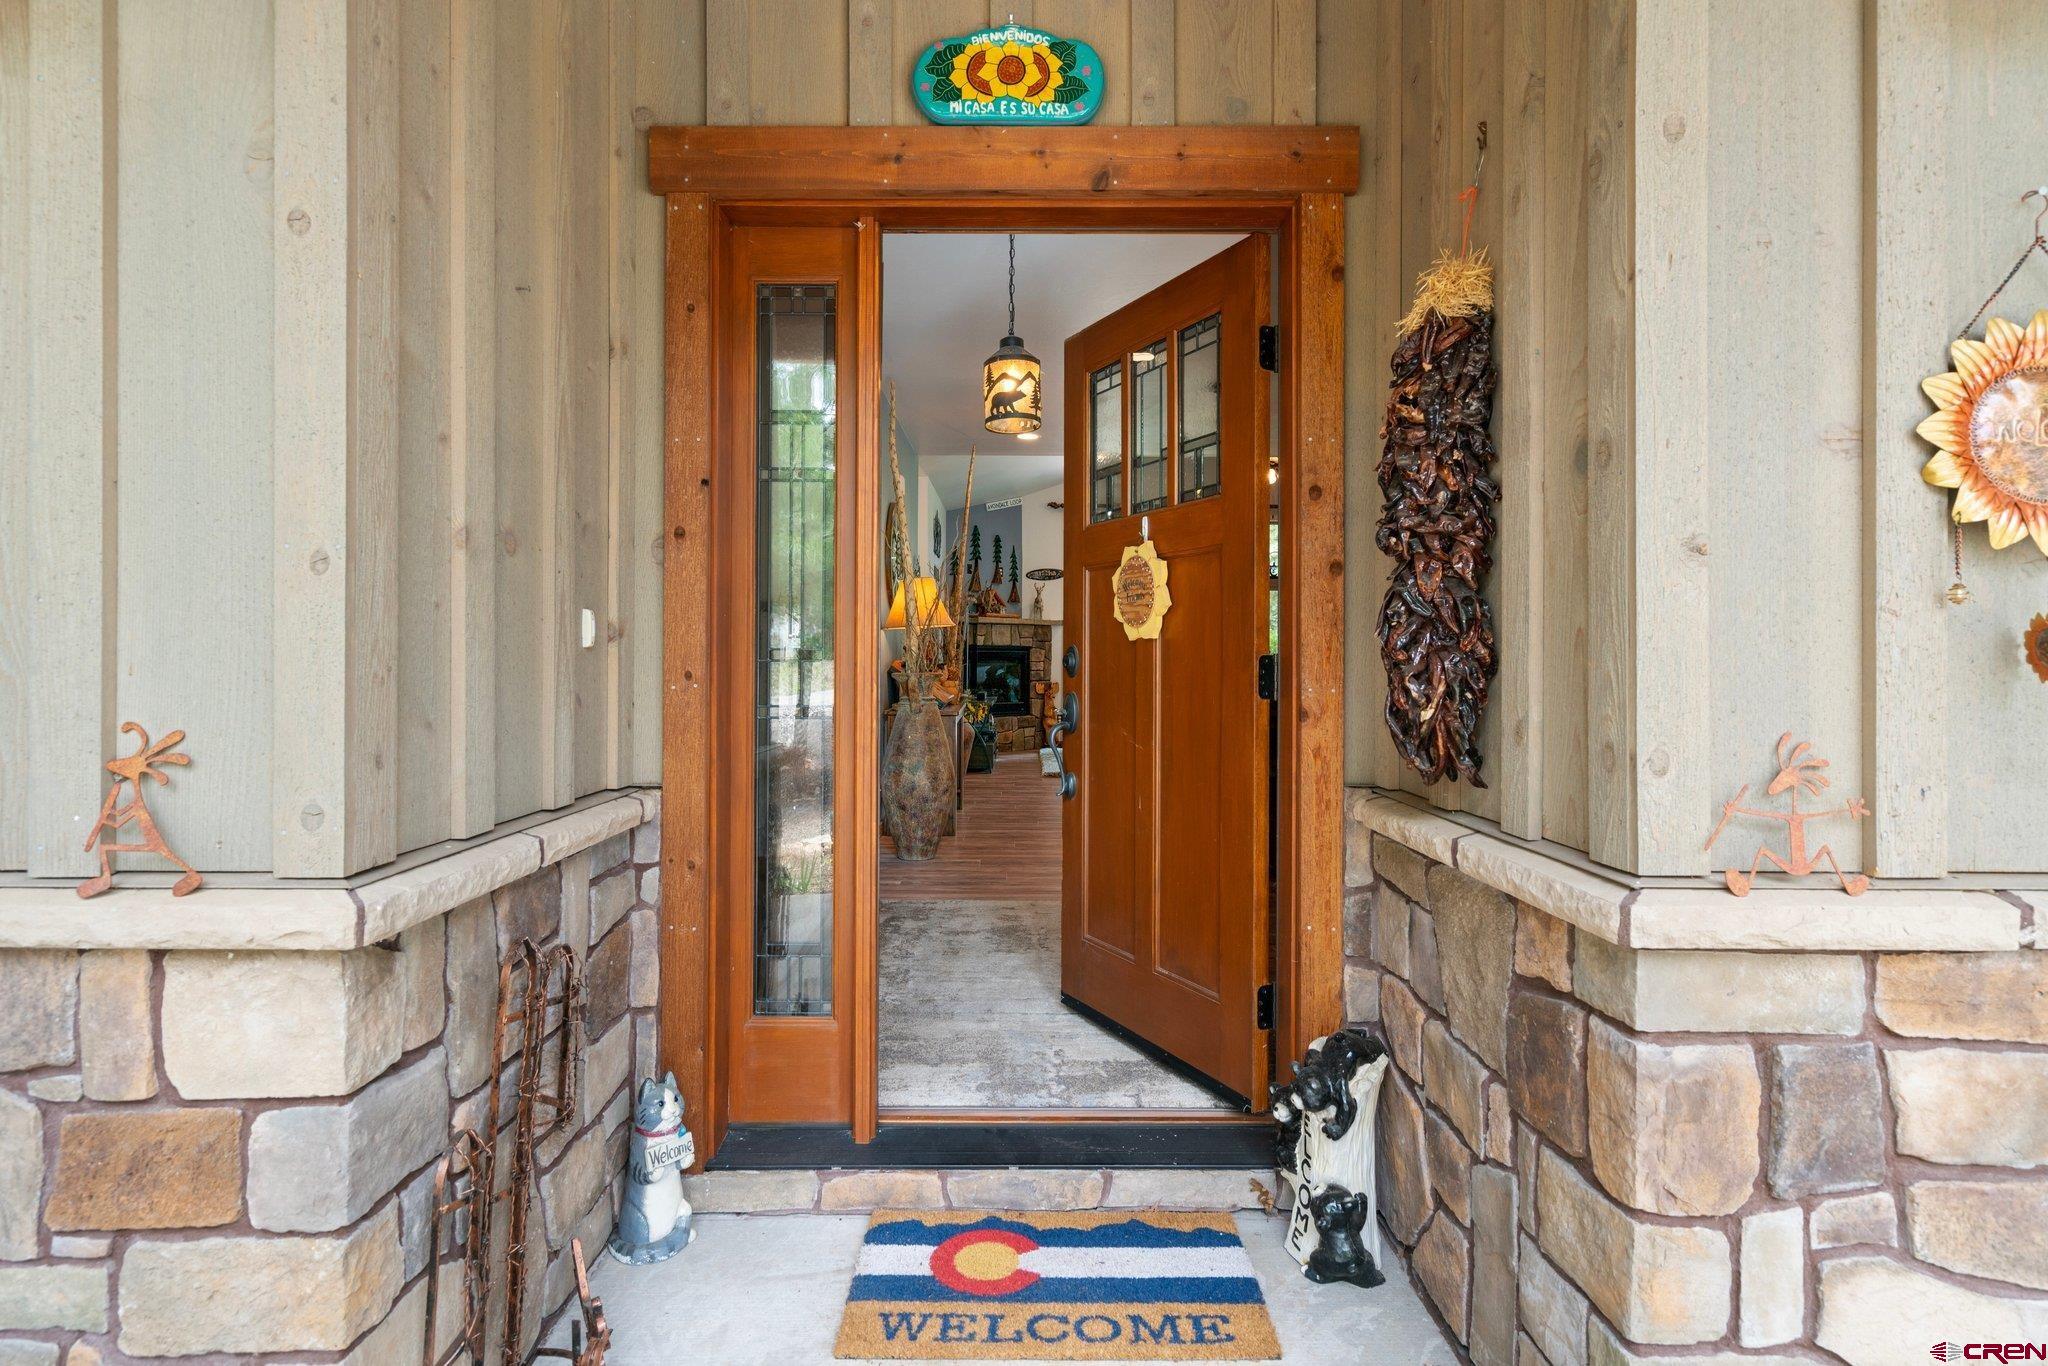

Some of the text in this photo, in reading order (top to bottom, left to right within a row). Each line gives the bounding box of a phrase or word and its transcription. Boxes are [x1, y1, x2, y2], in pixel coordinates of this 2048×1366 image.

[971, 29, 1050, 46] BIENVENIDOS
[965, 101, 995, 114] CASA
[1000, 101, 1018, 115] ES
[1021, 101, 1037, 115] SU
[1039, 102, 1069, 115] CASA
[649, 1140, 692, 1167] Welcome
[878, 1311, 1236, 1345] WELCOME
